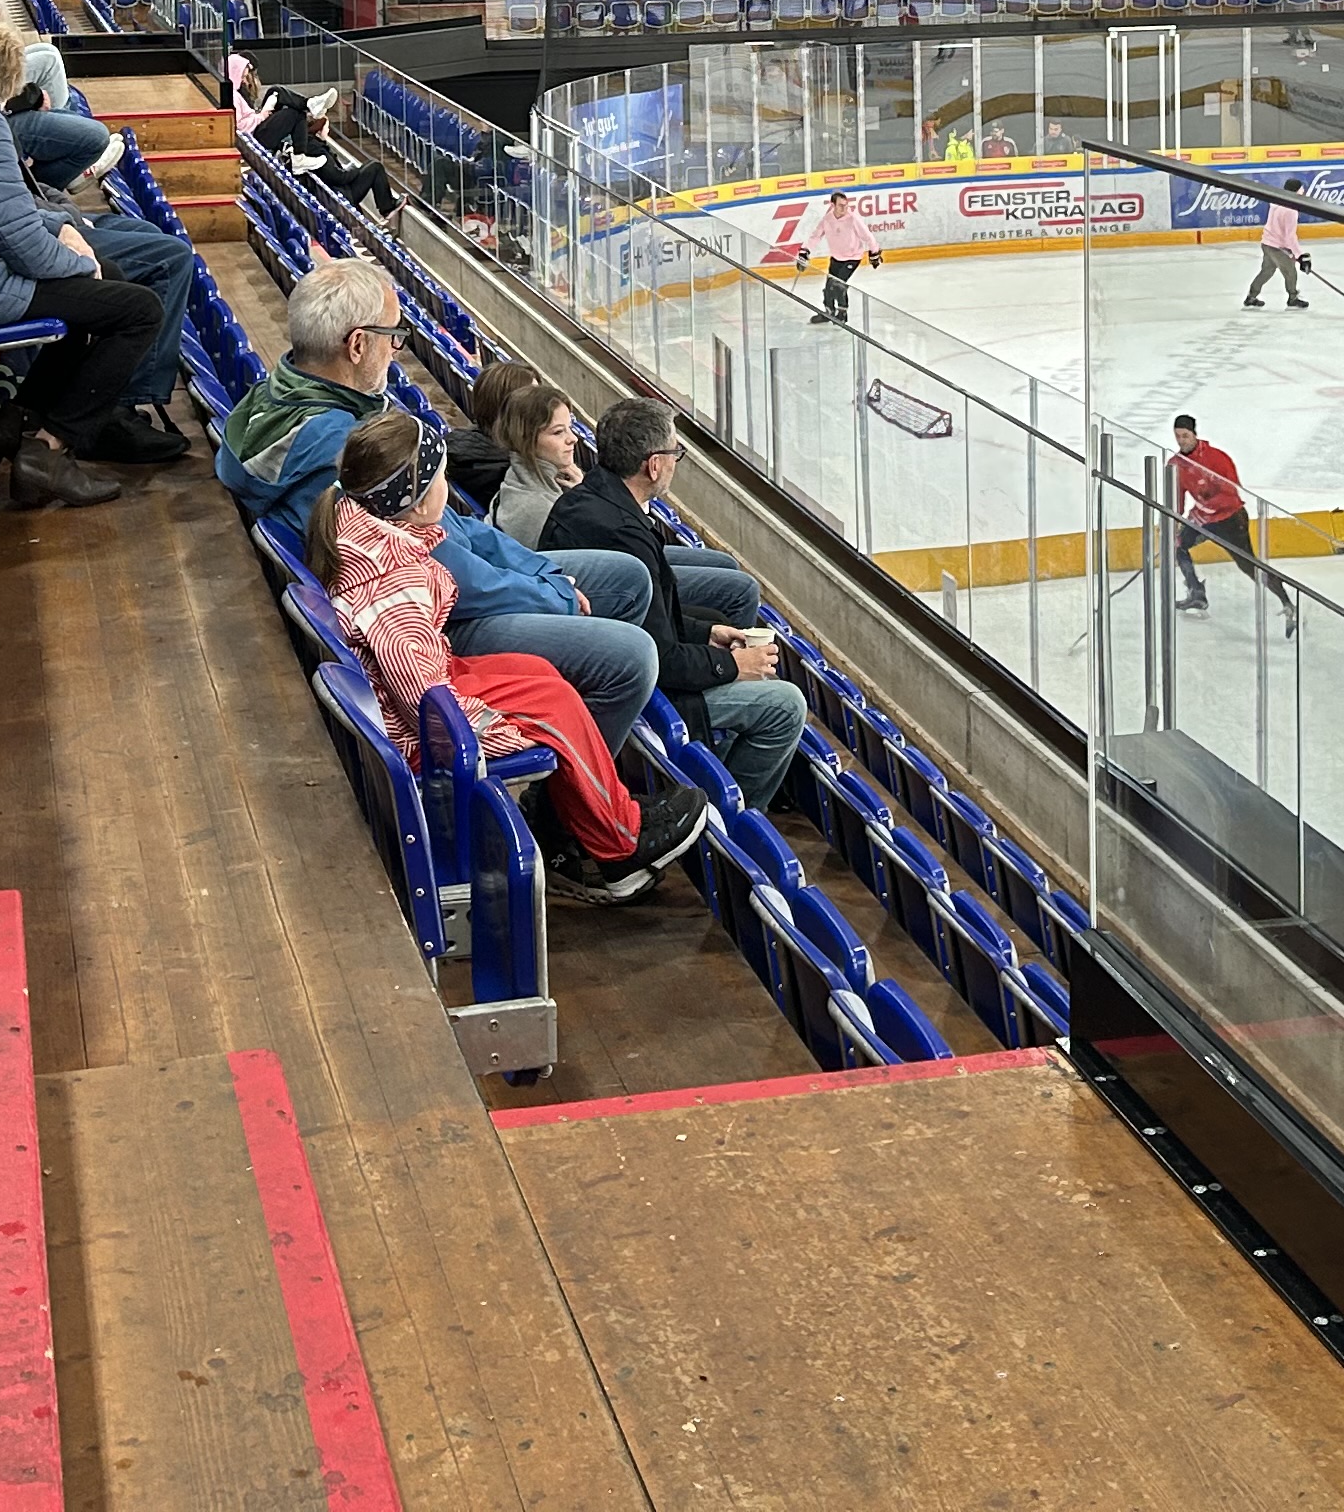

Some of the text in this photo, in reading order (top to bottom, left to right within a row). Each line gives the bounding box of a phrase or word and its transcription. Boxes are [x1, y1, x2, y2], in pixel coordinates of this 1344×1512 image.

[968, 190, 1071, 208] FENSTER
[1100, 201, 1136, 215] AG
[972, 229, 1033, 240] FENSTER
